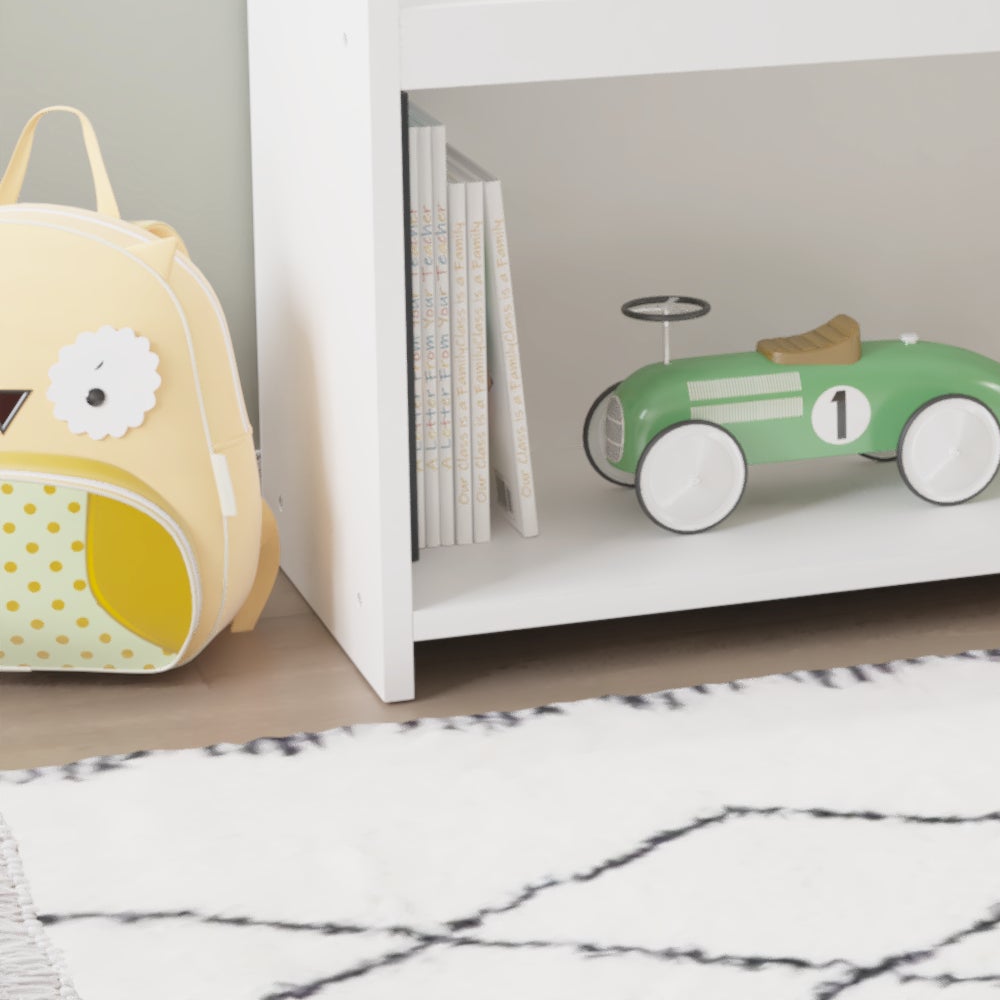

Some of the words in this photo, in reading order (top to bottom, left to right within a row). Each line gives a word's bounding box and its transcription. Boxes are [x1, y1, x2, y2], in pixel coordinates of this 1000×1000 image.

[421, 204, 433, 283] Teacher
[435, 203, 448, 282] Teacher
[423, 288, 434, 329] Your
[437, 287, 449, 328] Your
[424, 335, 436, 383] From
[439, 333, 451, 381] From
[830, 389, 847, 440] 1
